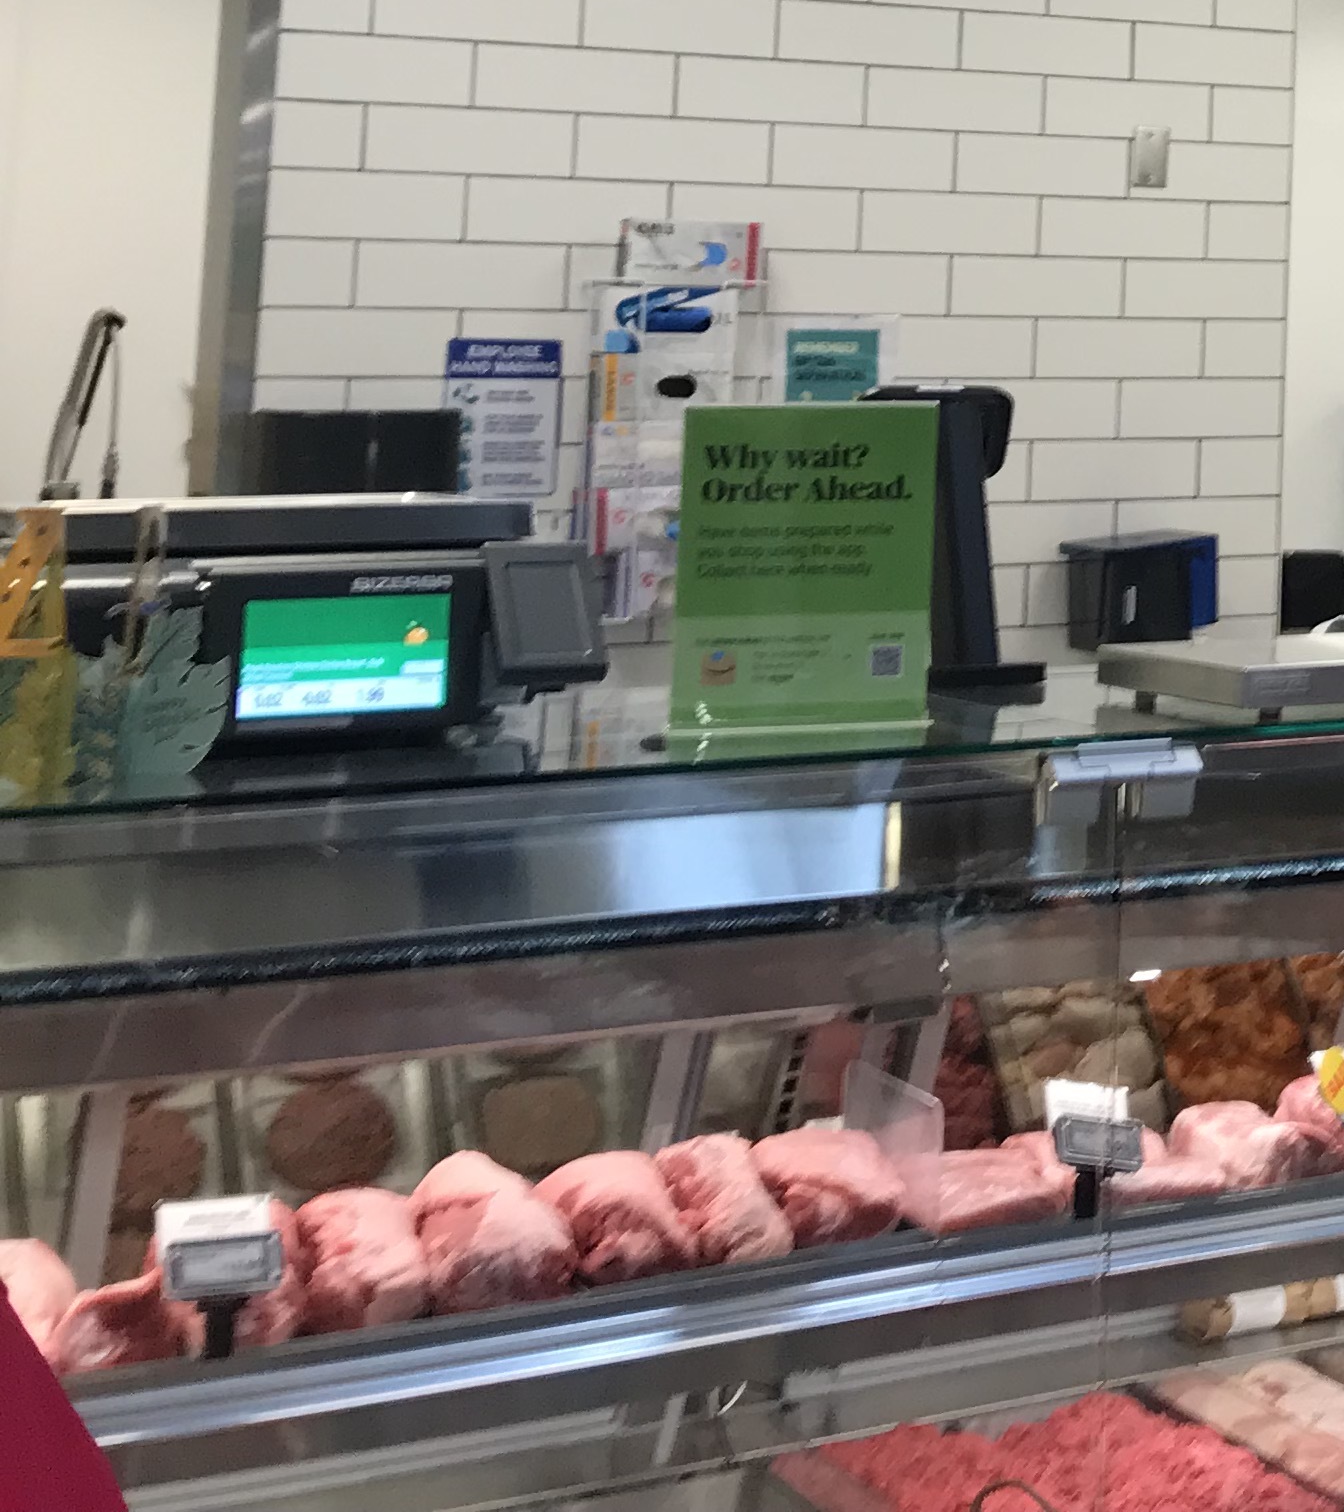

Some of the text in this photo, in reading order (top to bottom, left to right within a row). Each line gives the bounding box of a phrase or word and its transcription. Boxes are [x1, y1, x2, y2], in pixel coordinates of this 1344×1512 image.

[704, 443, 778, 476] Why
[785, 441, 871, 469] wait?
[702, 473, 800, 503] Order
[809, 473, 914, 502] Ahead.
